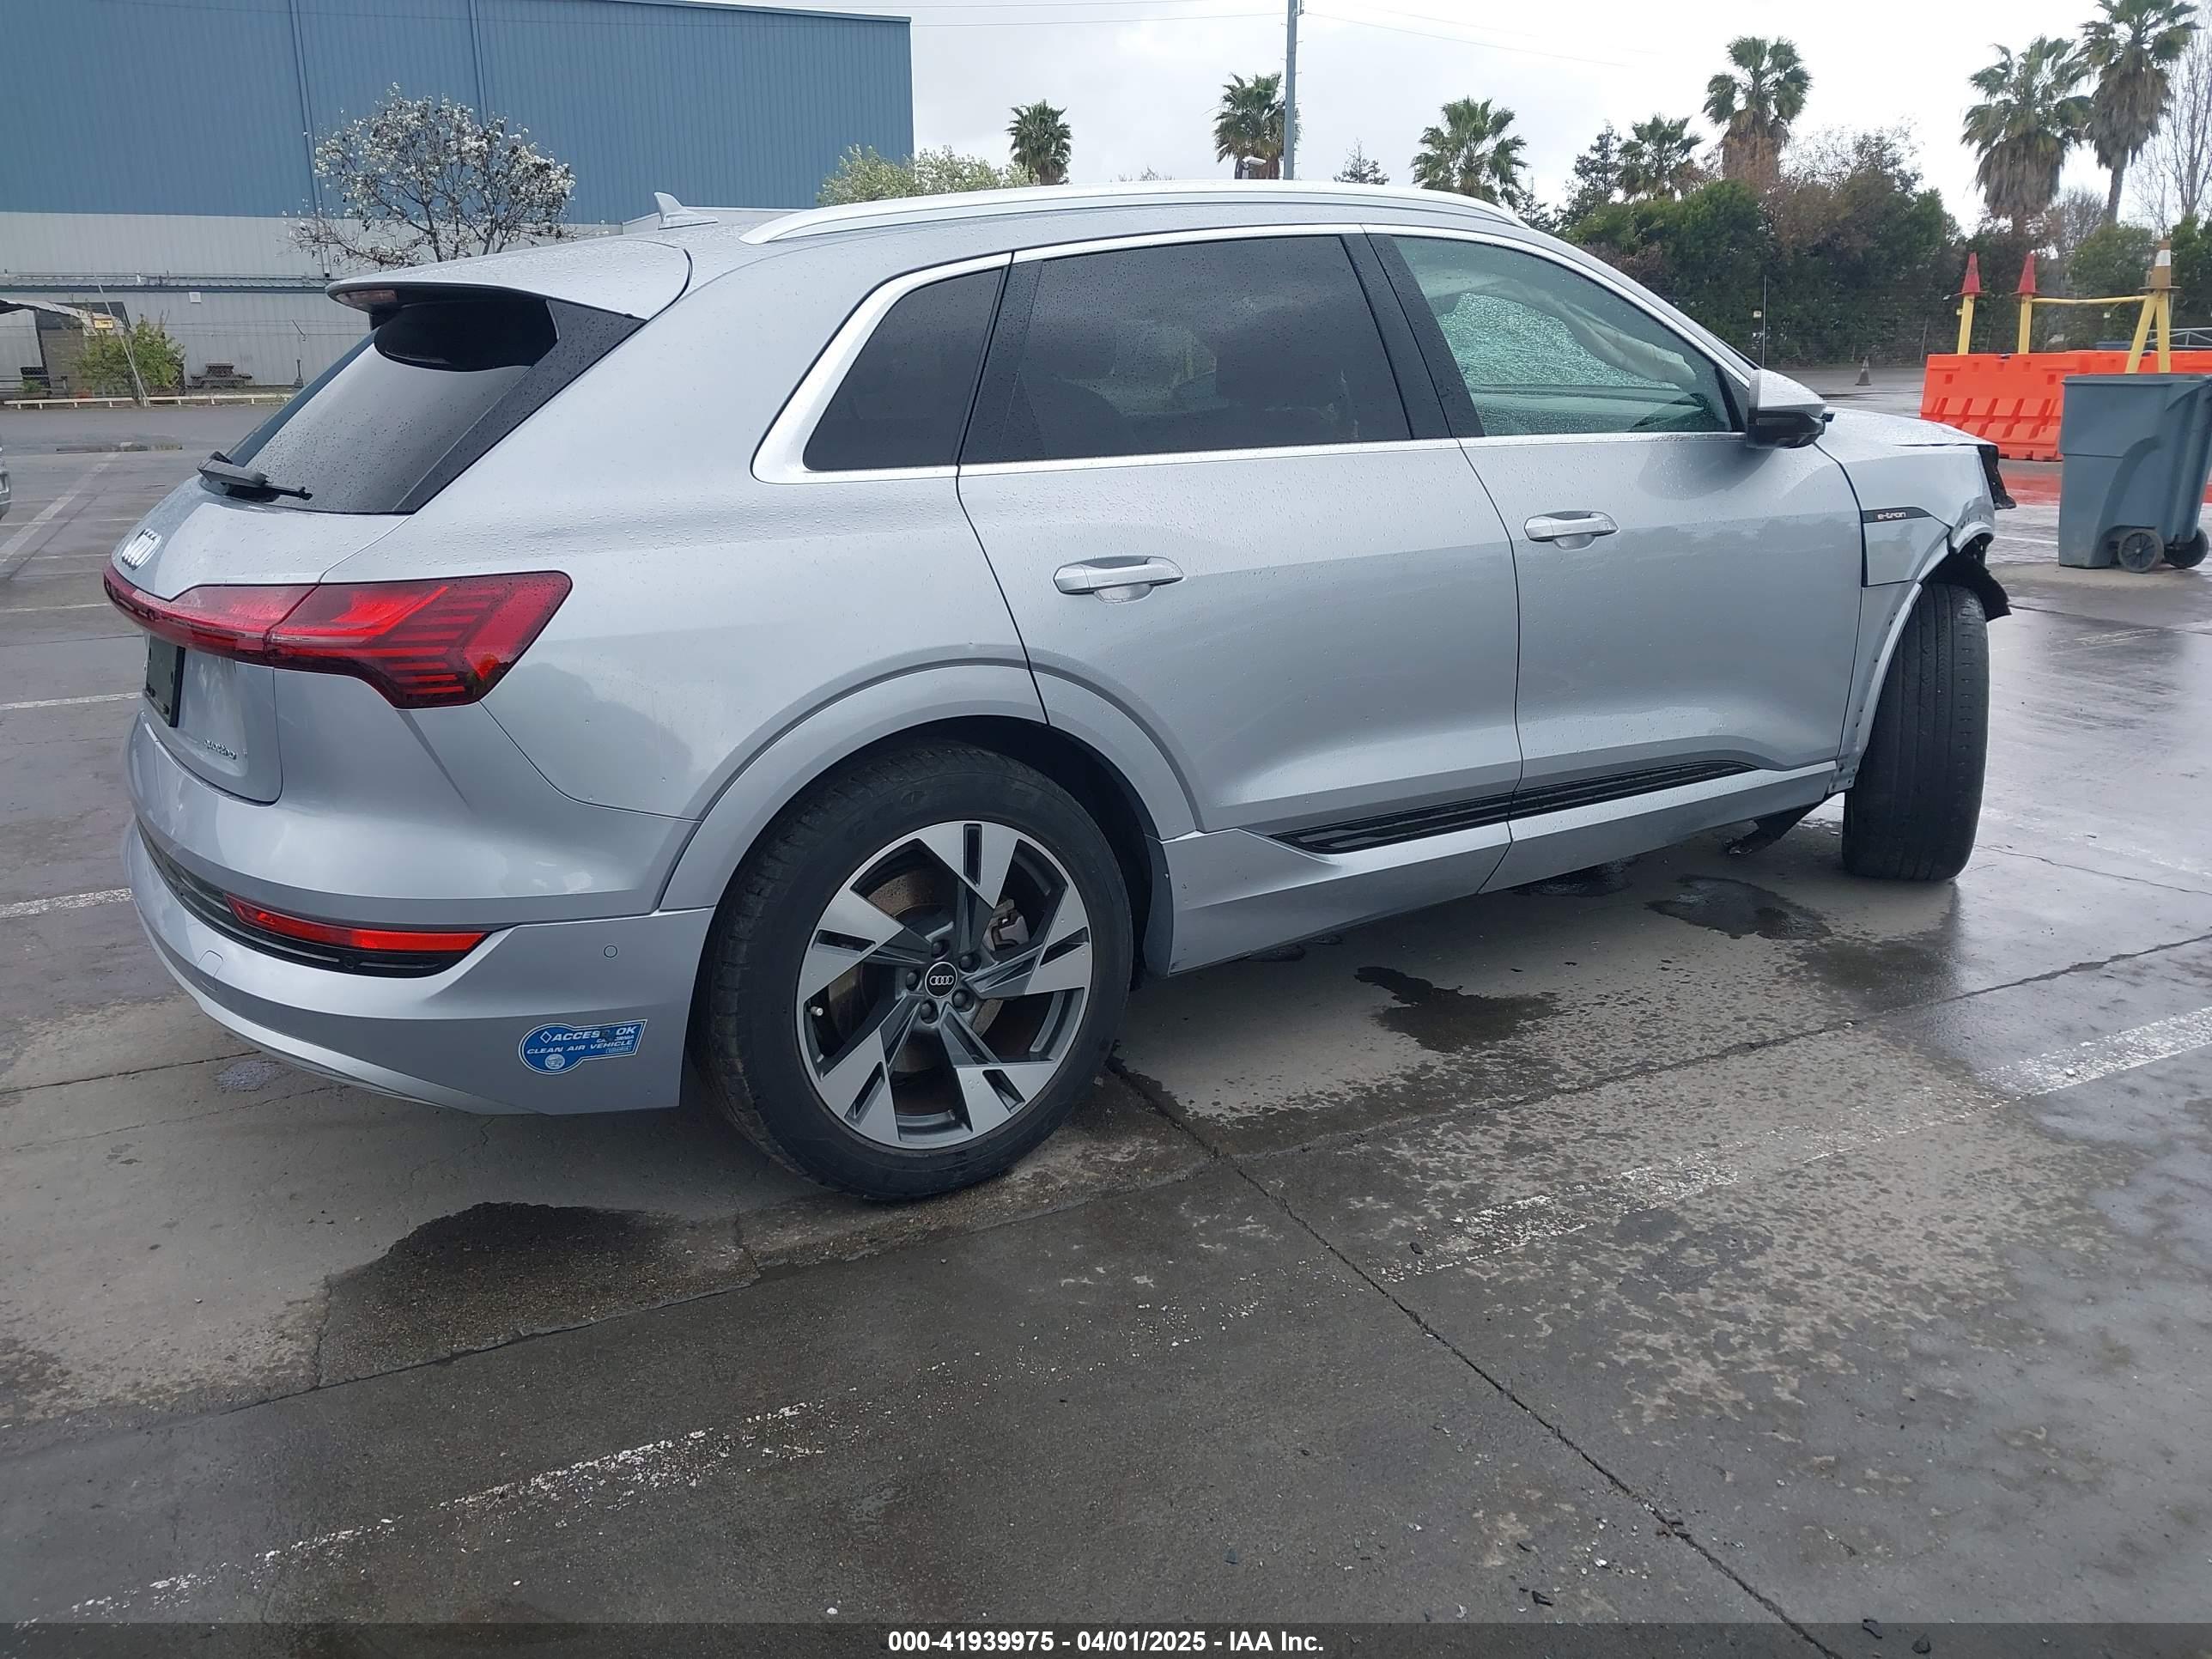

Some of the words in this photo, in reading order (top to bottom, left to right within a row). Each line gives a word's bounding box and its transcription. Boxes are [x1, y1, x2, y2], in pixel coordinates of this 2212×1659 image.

[551, 1030, 611, 1042] ACCES
[616, 1026, 637, 1036] OK
[590, 1039, 634, 1049] VEHICLE
